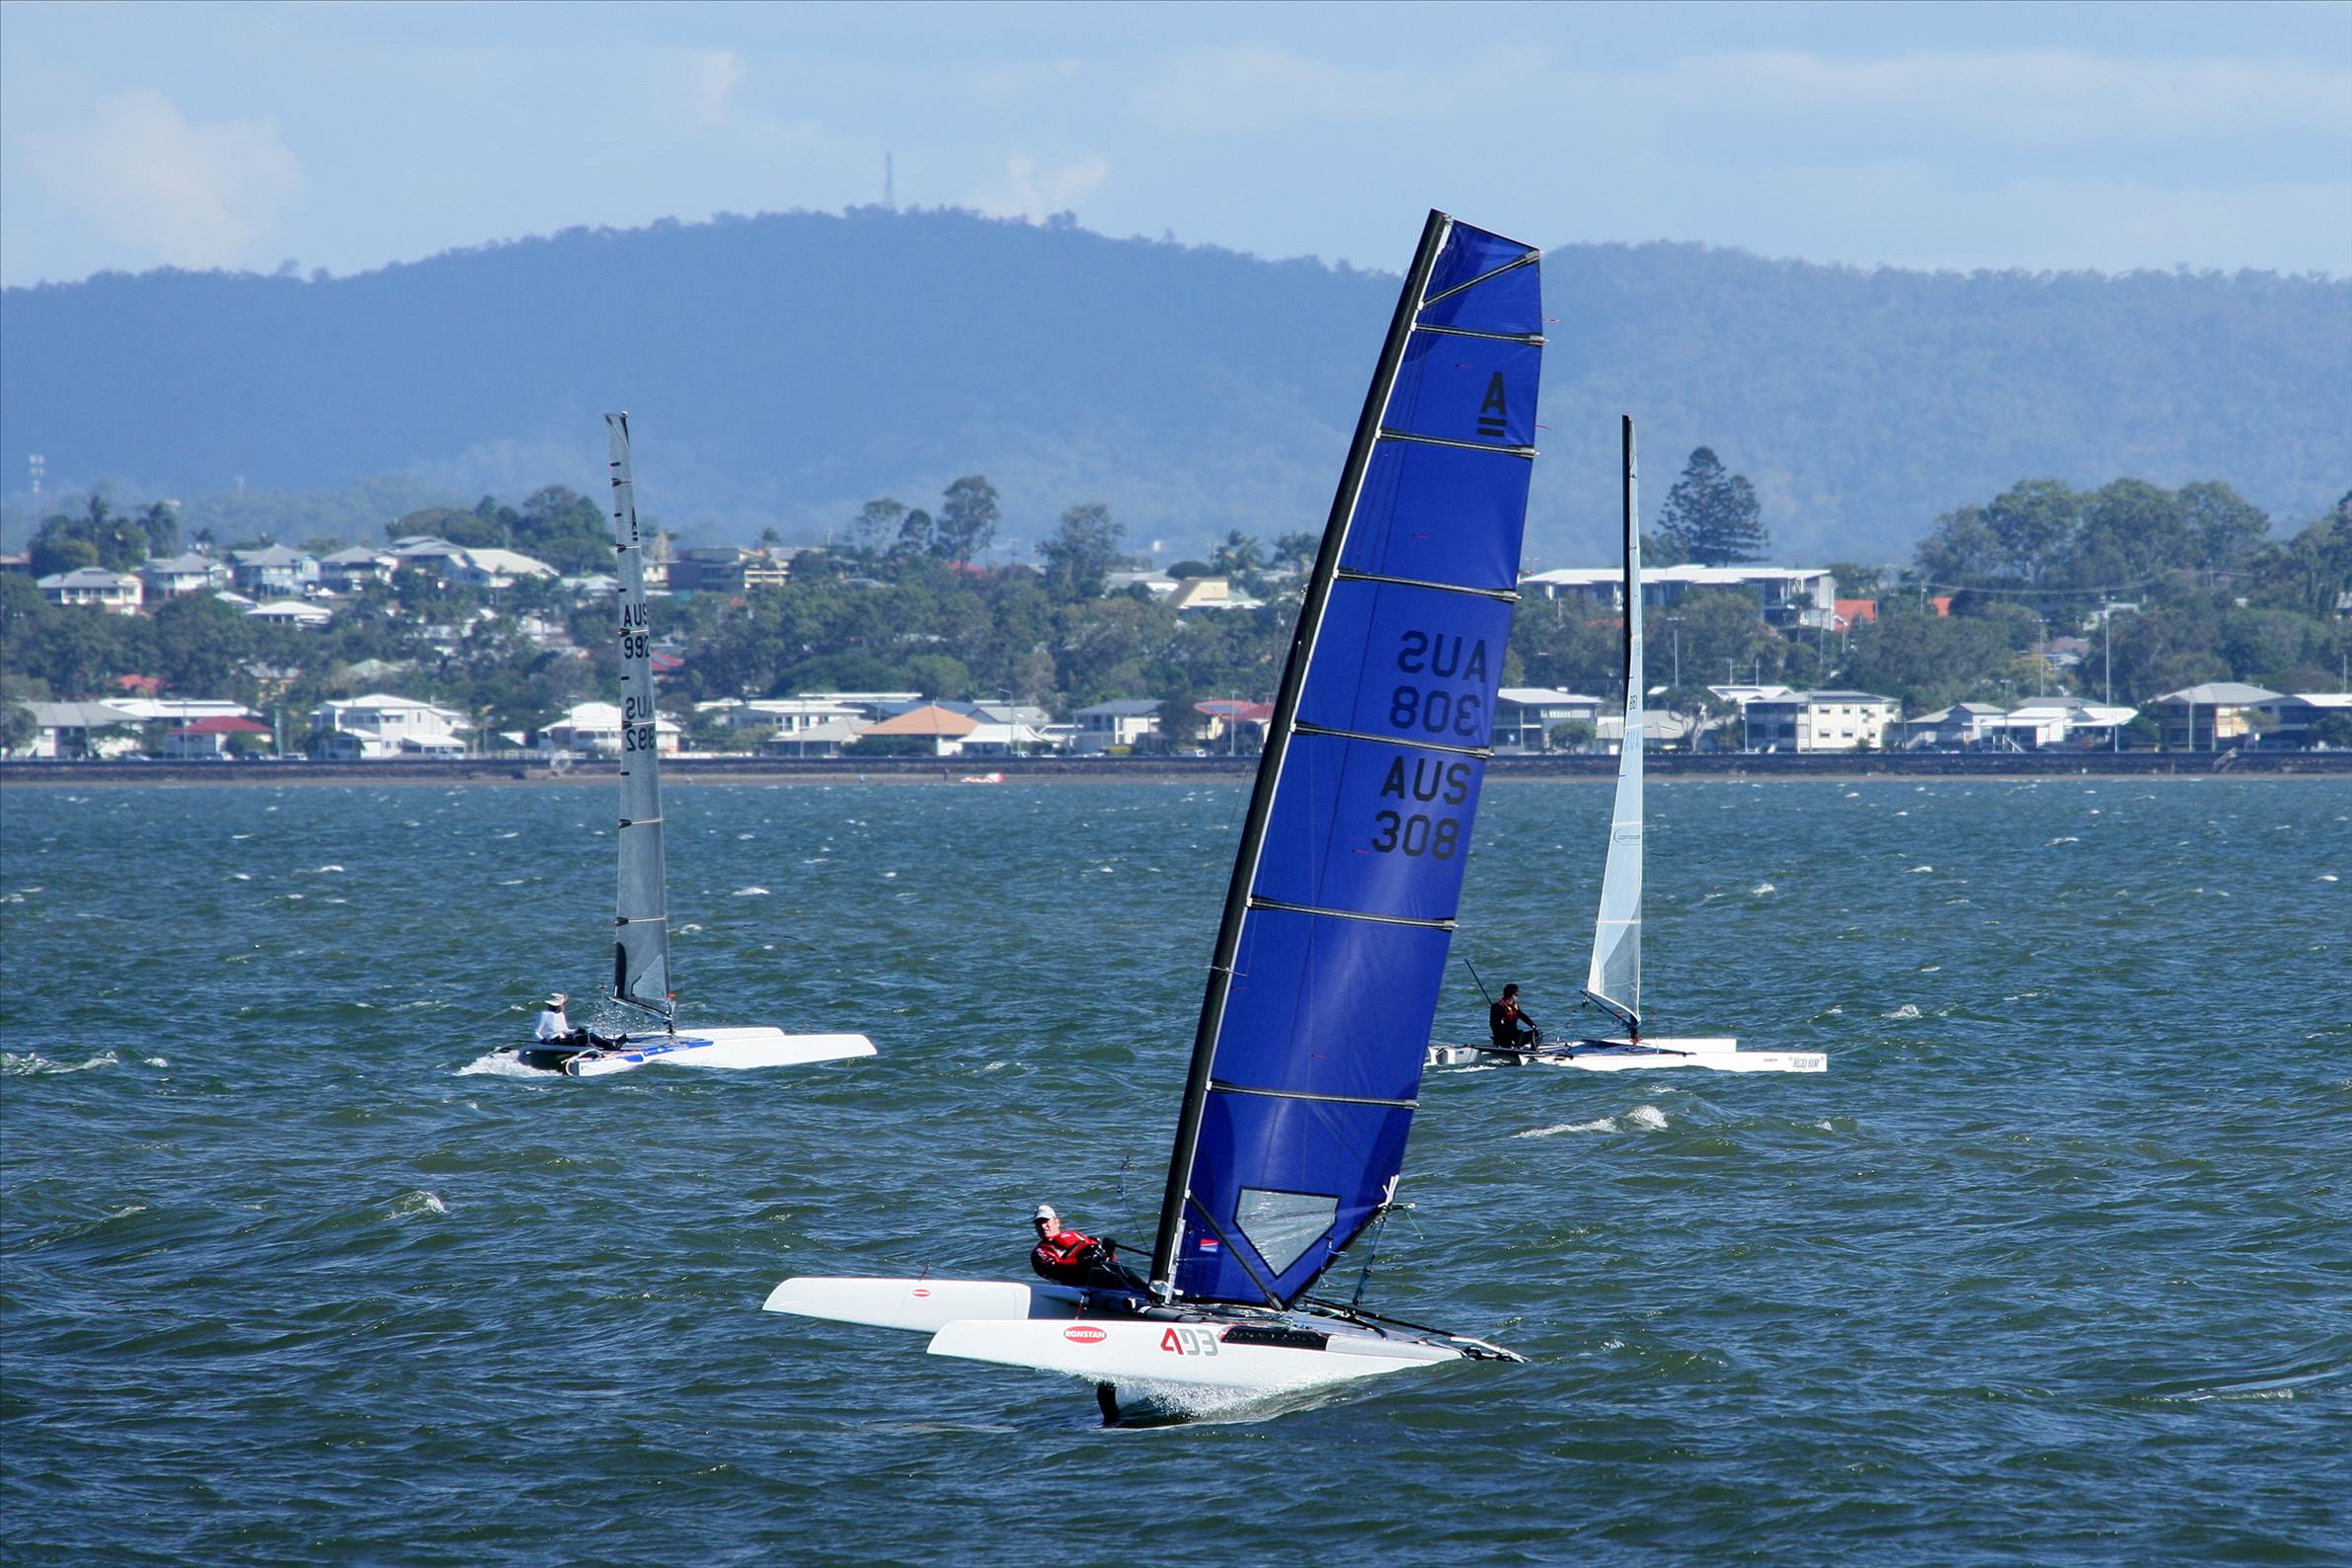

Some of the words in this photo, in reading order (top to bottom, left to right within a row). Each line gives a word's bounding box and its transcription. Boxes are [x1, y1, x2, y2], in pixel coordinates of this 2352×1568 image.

[1480, 370, 1508, 416] A
[1380, 755, 1471, 806] AUS
[1372, 810, 1459, 861] 308
